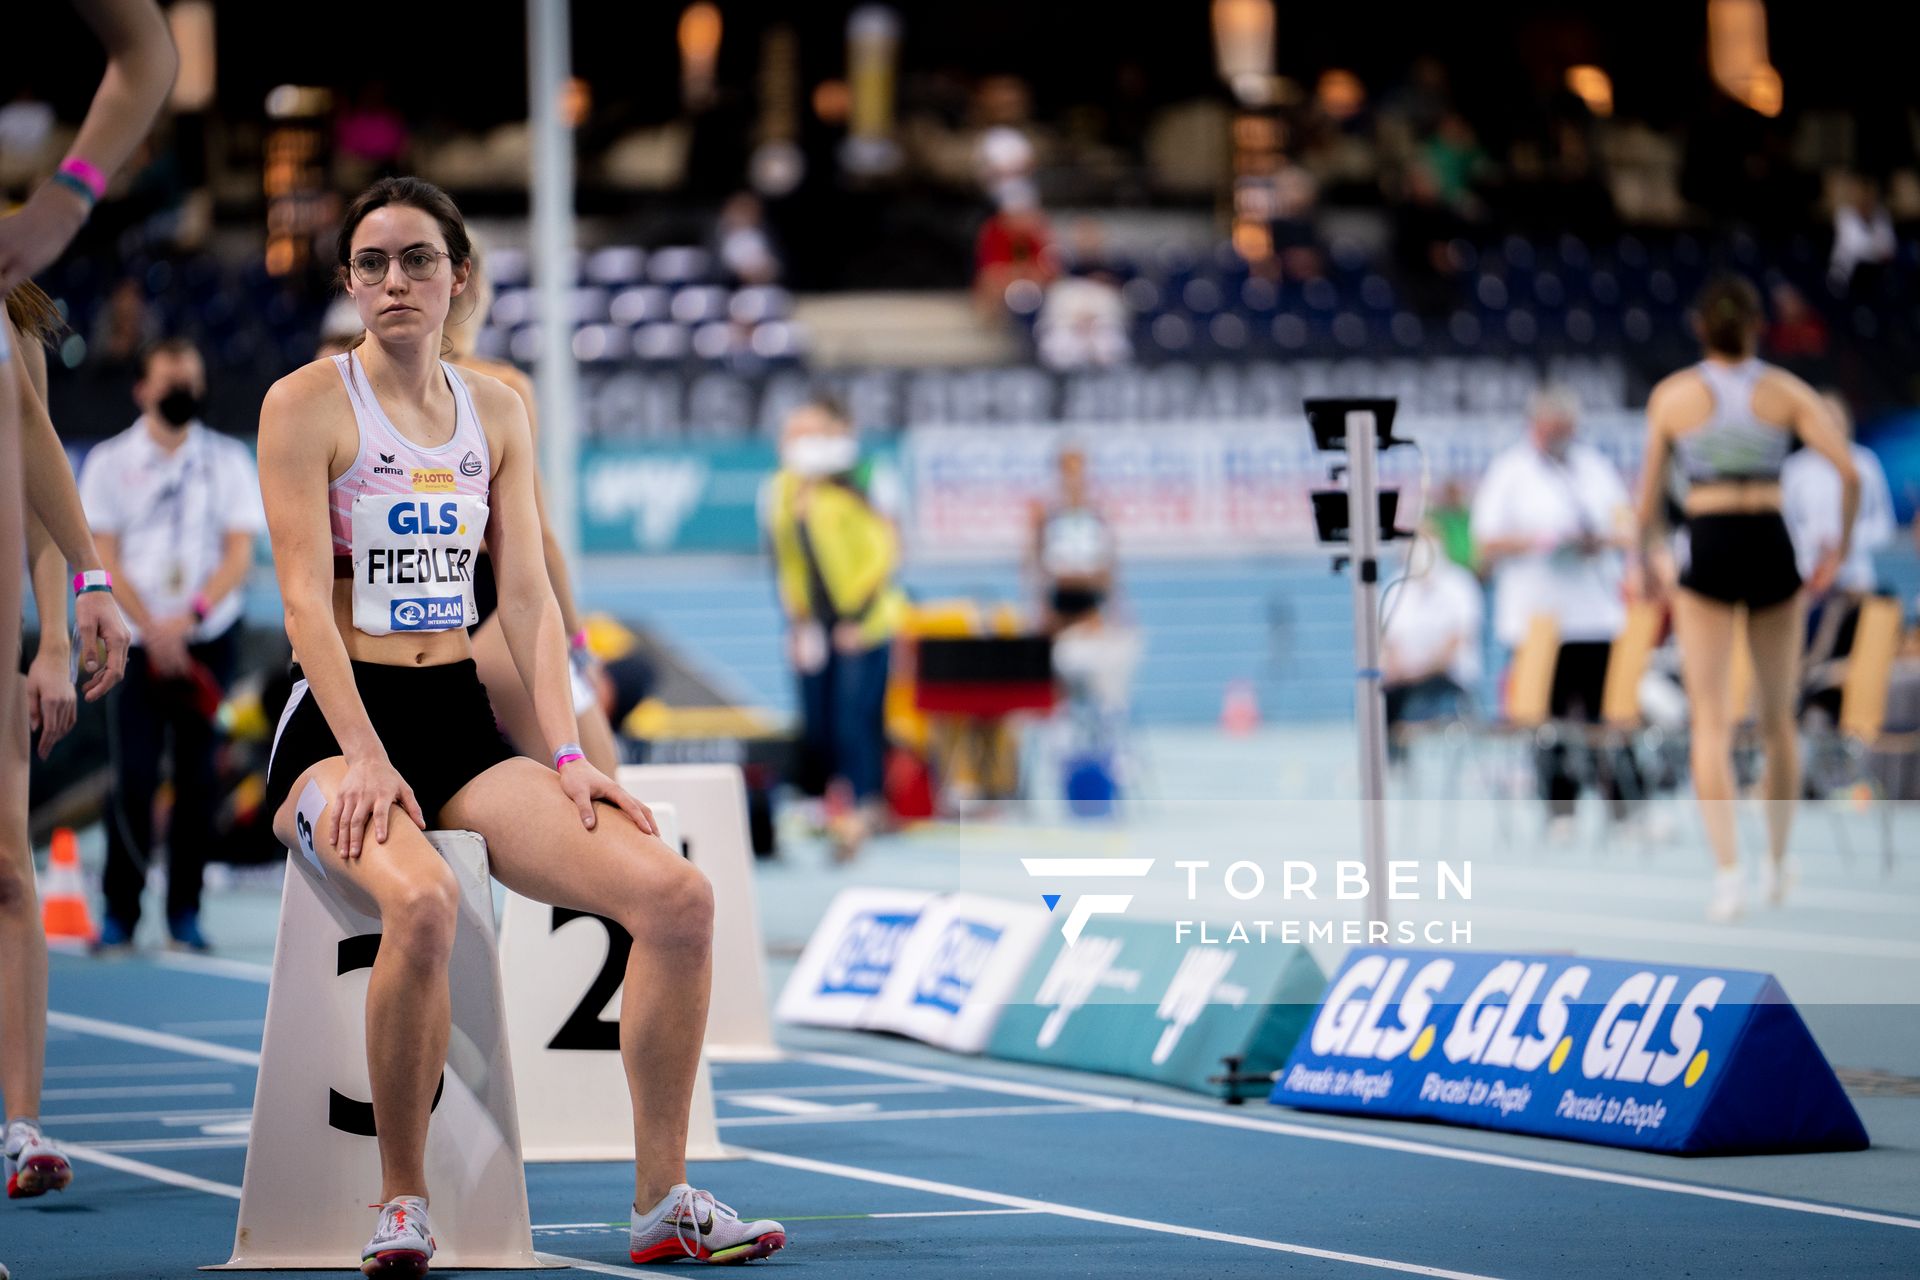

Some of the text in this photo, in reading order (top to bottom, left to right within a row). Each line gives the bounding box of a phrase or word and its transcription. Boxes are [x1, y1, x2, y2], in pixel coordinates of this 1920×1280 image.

[374, 466, 404, 476] erima
[424, 473, 454, 483] LOTTO
[367, 547, 472, 585] FIEDLER
[427, 601, 462, 618] PLAN
[296, 811, 314, 852] 3
[546, 905, 633, 1051] 2
[1555, 1089, 1607, 1123] Parcels
[1616, 1097, 1668, 1136] People
